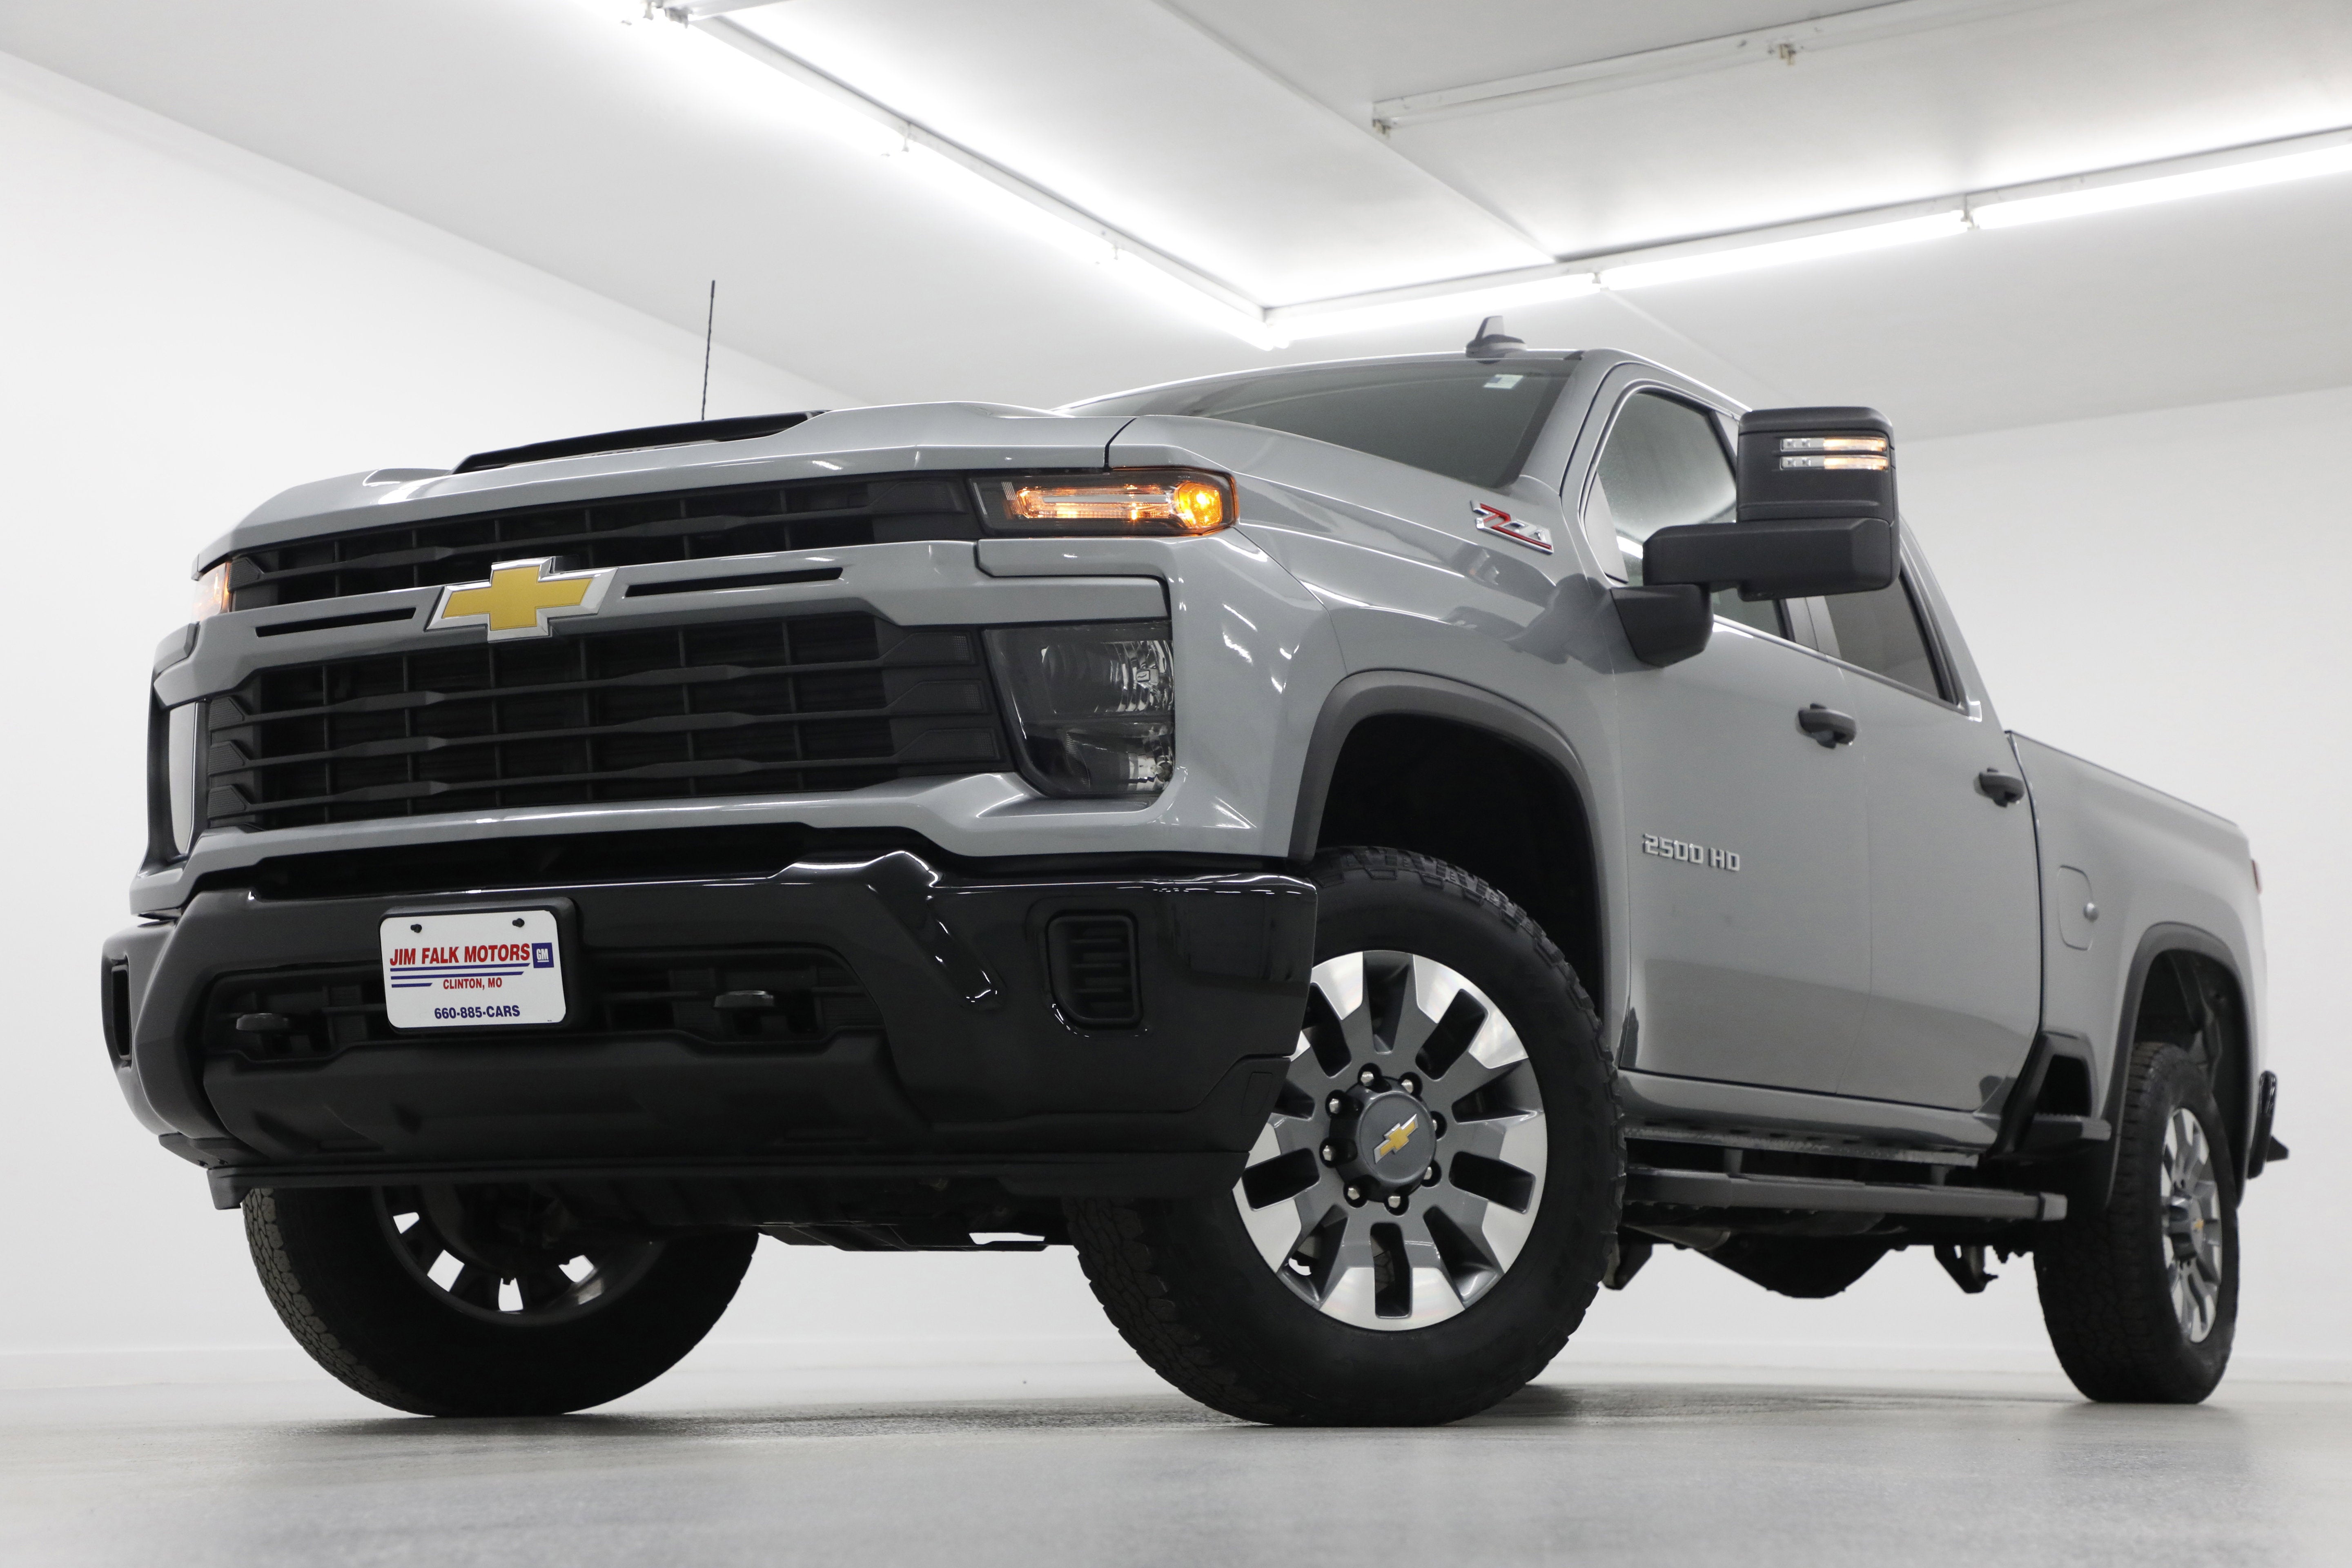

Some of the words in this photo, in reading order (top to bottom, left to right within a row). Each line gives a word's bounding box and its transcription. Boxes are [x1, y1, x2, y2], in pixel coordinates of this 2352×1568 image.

[1643, 833, 1704, 864] 2500
[1709, 848, 1740, 871] HD
[390, 948, 416, 966] JIM
[422, 947, 459, 964] FALK
[464, 943, 530, 962] MOTORS
[536, 949, 549, 961] GM
[443, 978, 485, 990] CLINTON,
[488, 977, 502, 987] MO
[434, 1005, 520, 1019] 660-885-CARS
